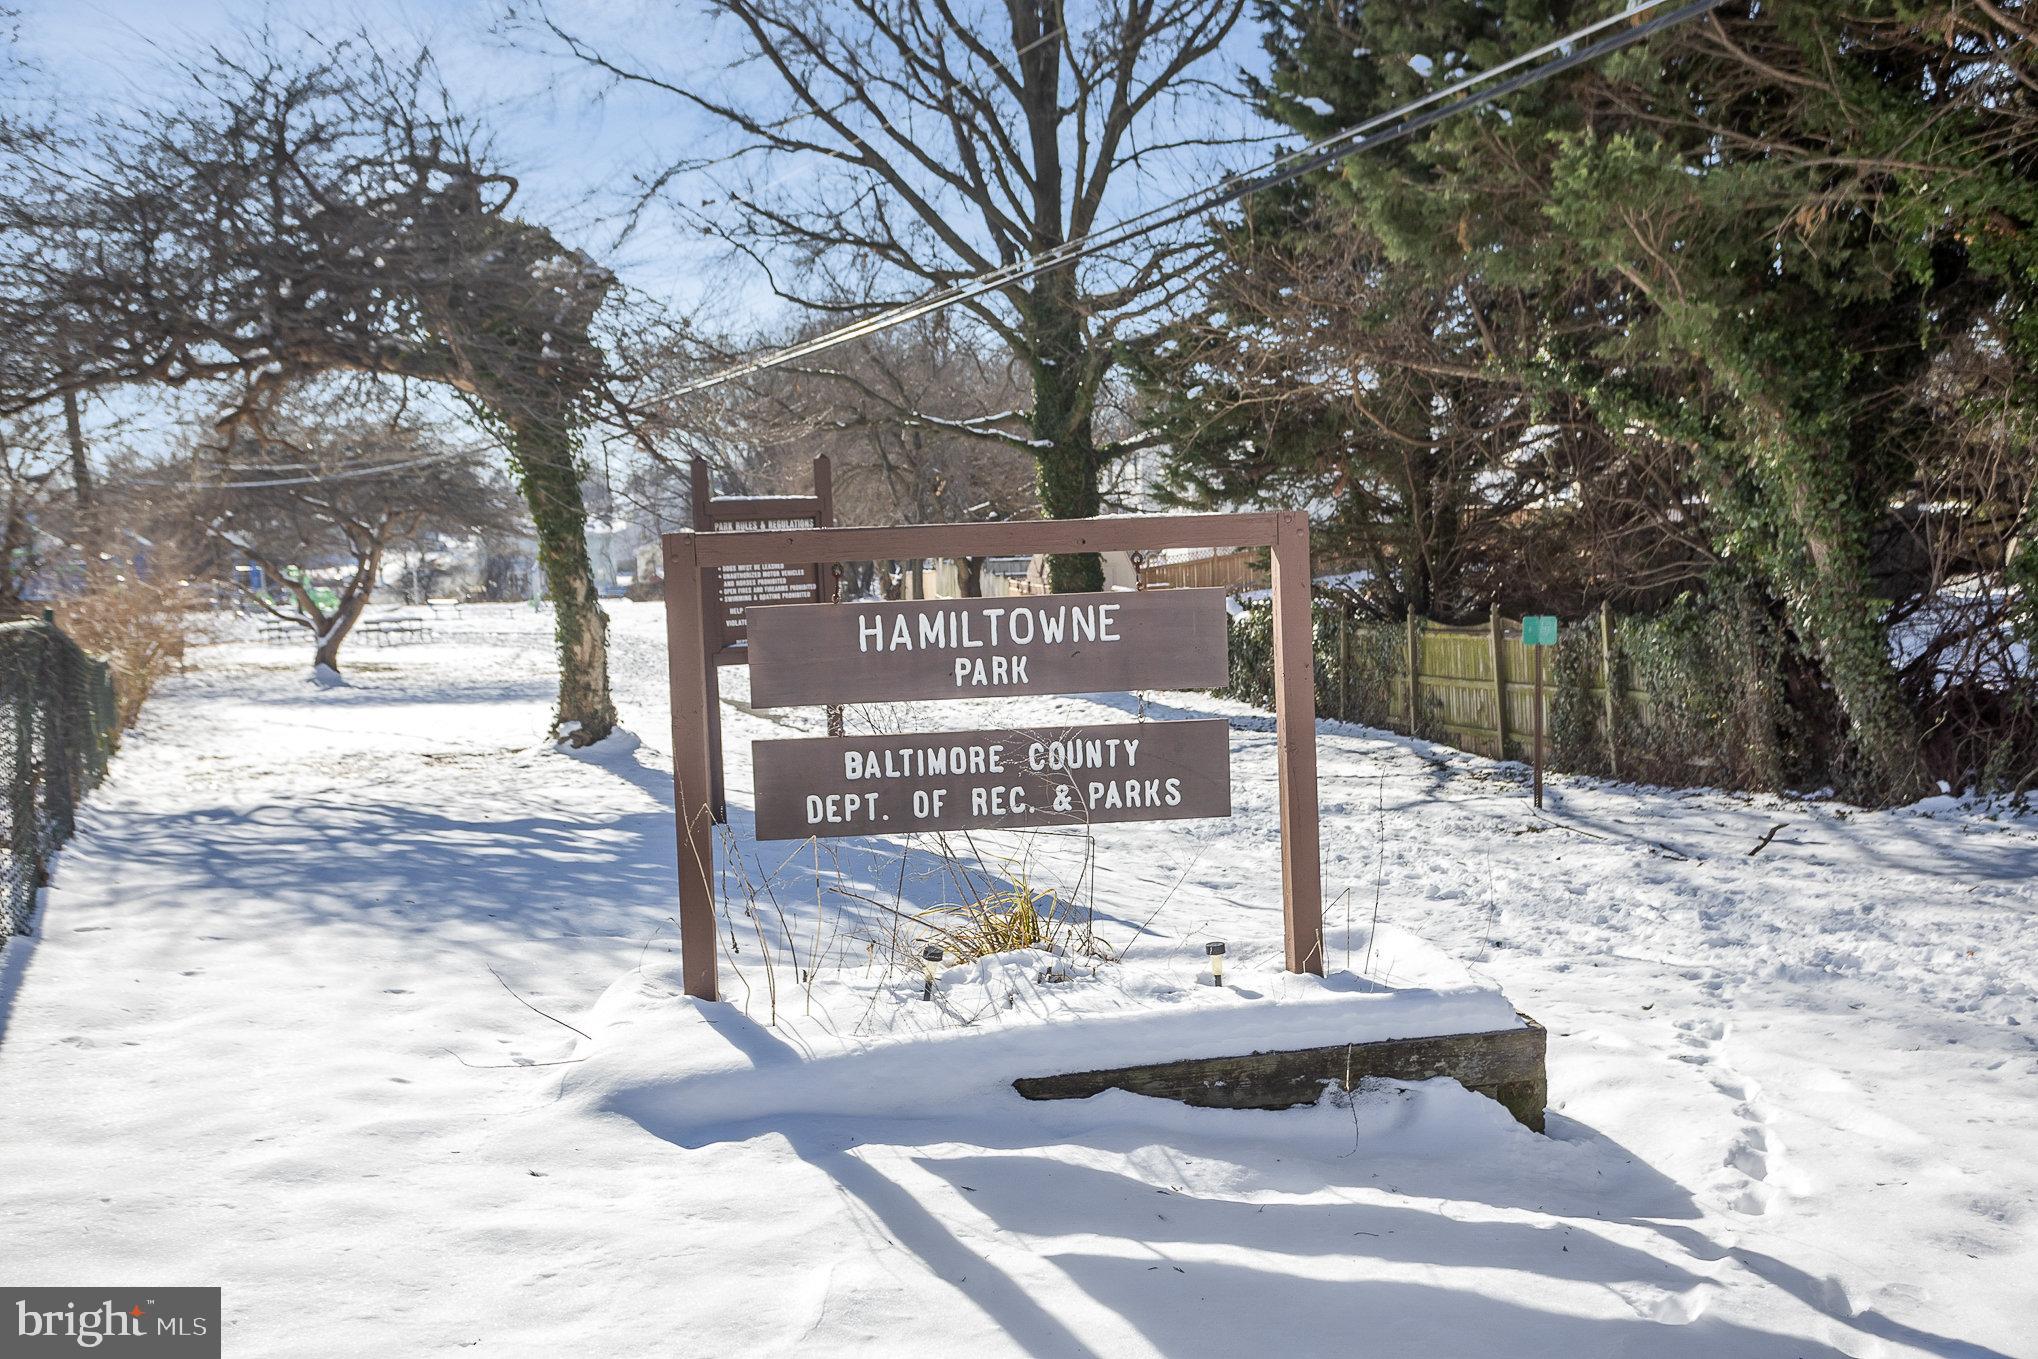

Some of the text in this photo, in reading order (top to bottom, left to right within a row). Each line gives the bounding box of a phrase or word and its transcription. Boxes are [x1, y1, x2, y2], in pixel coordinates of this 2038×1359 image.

[714, 522, 733, 532] PARK
[736, 521, 757, 531] RULES
[768, 518, 814, 529] REGULATIONS
[858, 604, 1121, 652] HAMILTOWNE
[955, 656, 1028, 686] PARK
[844, 738, 1140, 780] BALTIMORE COUNTY
[806, 778, 1182, 825] DEPT. OF REC. & PARKS
